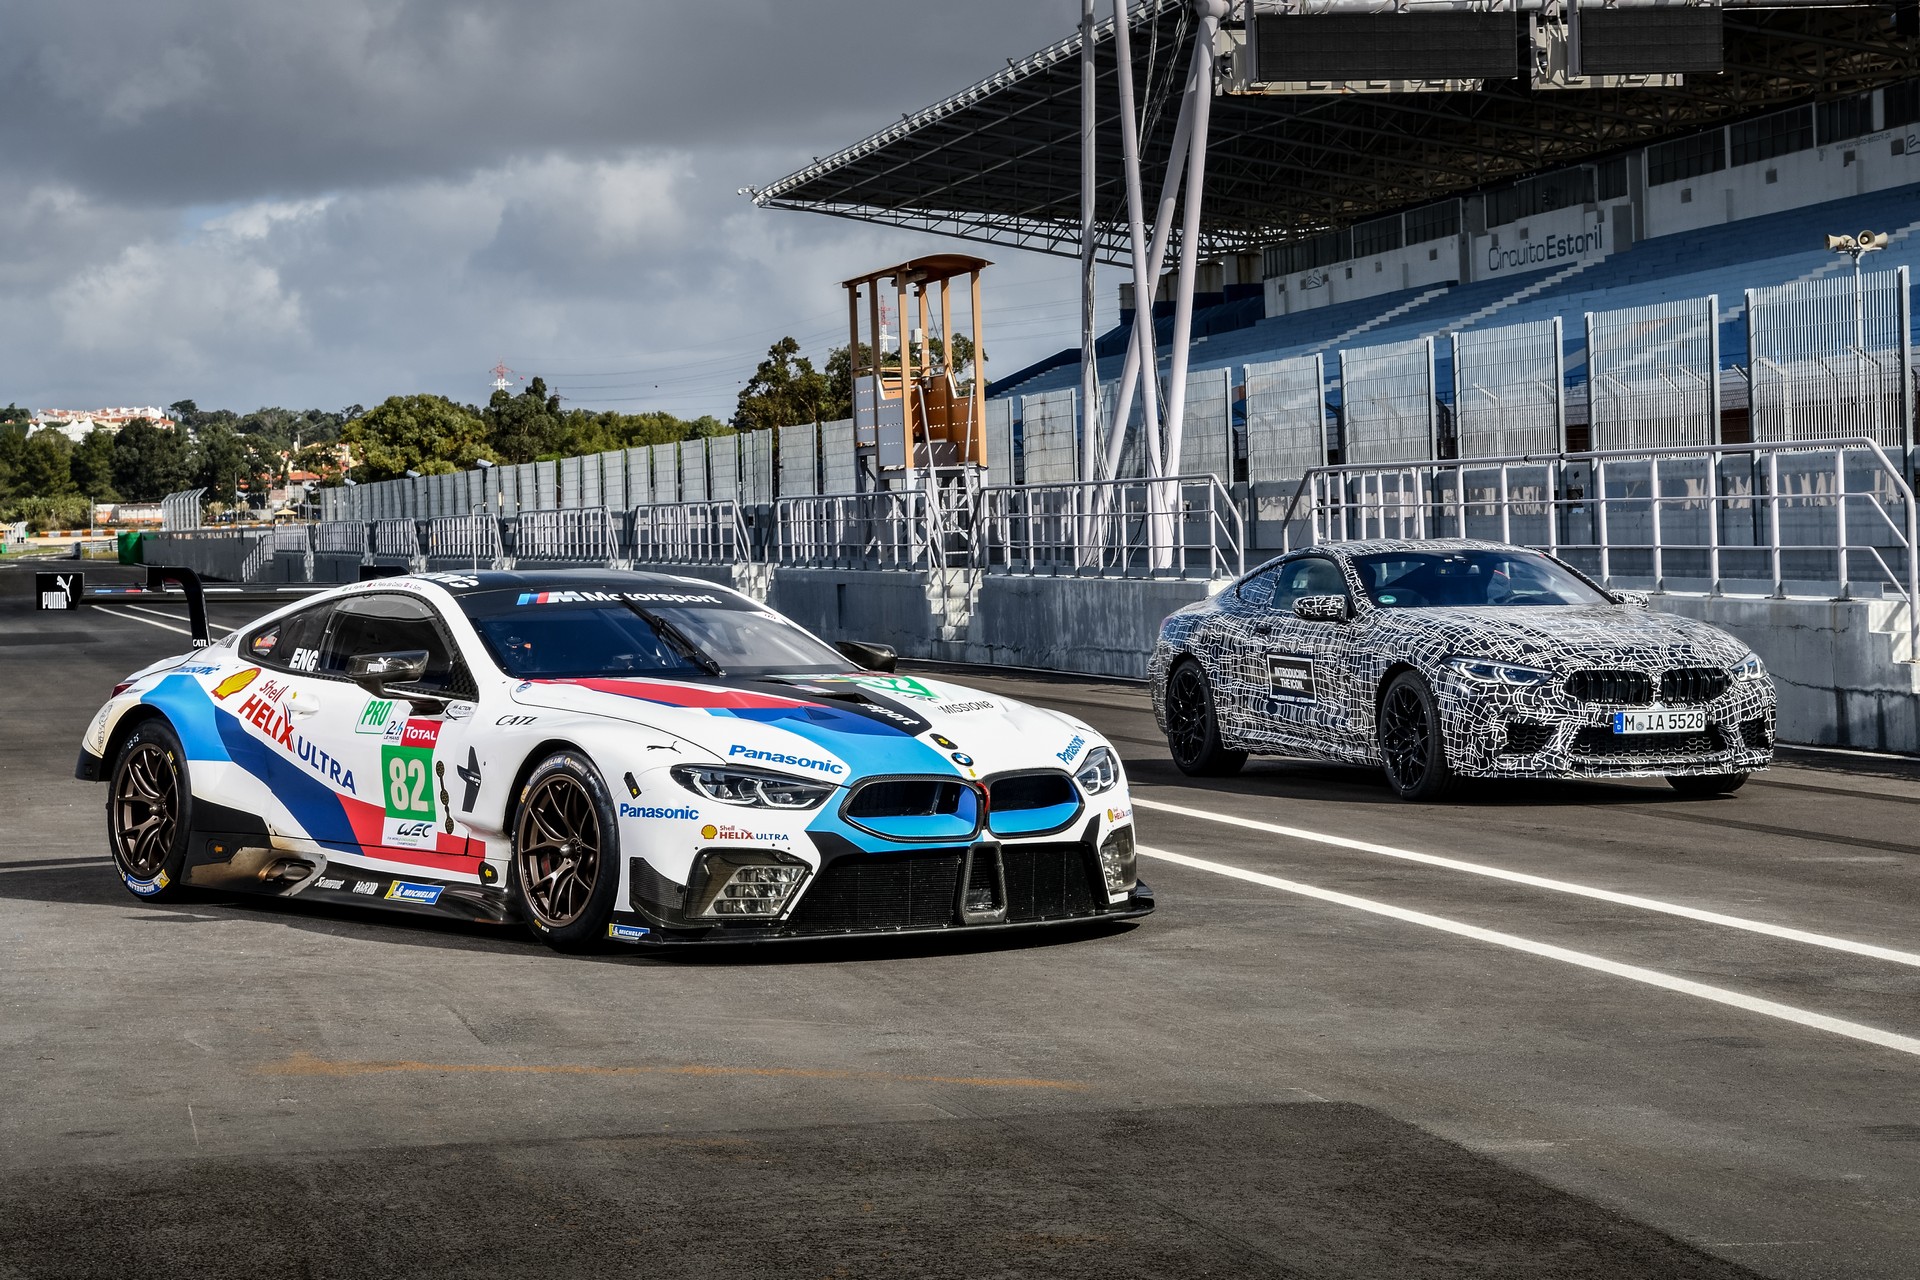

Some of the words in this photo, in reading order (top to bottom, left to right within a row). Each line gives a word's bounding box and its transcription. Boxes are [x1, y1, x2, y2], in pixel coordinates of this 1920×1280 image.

[42, 591, 68, 609] PUMA
[192, 638, 208, 648] CATL
[288, 647, 319, 672] ENG
[1274, 667, 1308, 680] INTRODUCING
[1280, 677, 1291, 688] THE
[259, 680, 290, 703] Shell
[360, 700, 393, 727] PRO
[495, 714, 538, 726] CATL
[1625, 715, 1634, 730] M
[1646, 714, 1664, 730] IA
[1669, 713, 1703, 729] 5528
[405, 726, 437, 741] TOTAL
[238, 693, 295, 753] HELIX
[297, 735, 357, 796] ULTRA
[1056, 734, 1085, 765] Panasonic
[728, 744, 843, 775] Panasonic
[389, 757, 429, 812] 82
[619, 802, 699, 821] Panasonic
[396, 822, 433, 838] WEC
[719, 829, 755, 840] HELIX
[755, 833, 789, 841] ULTRA
[402, 888, 437, 899] MICHELIN
